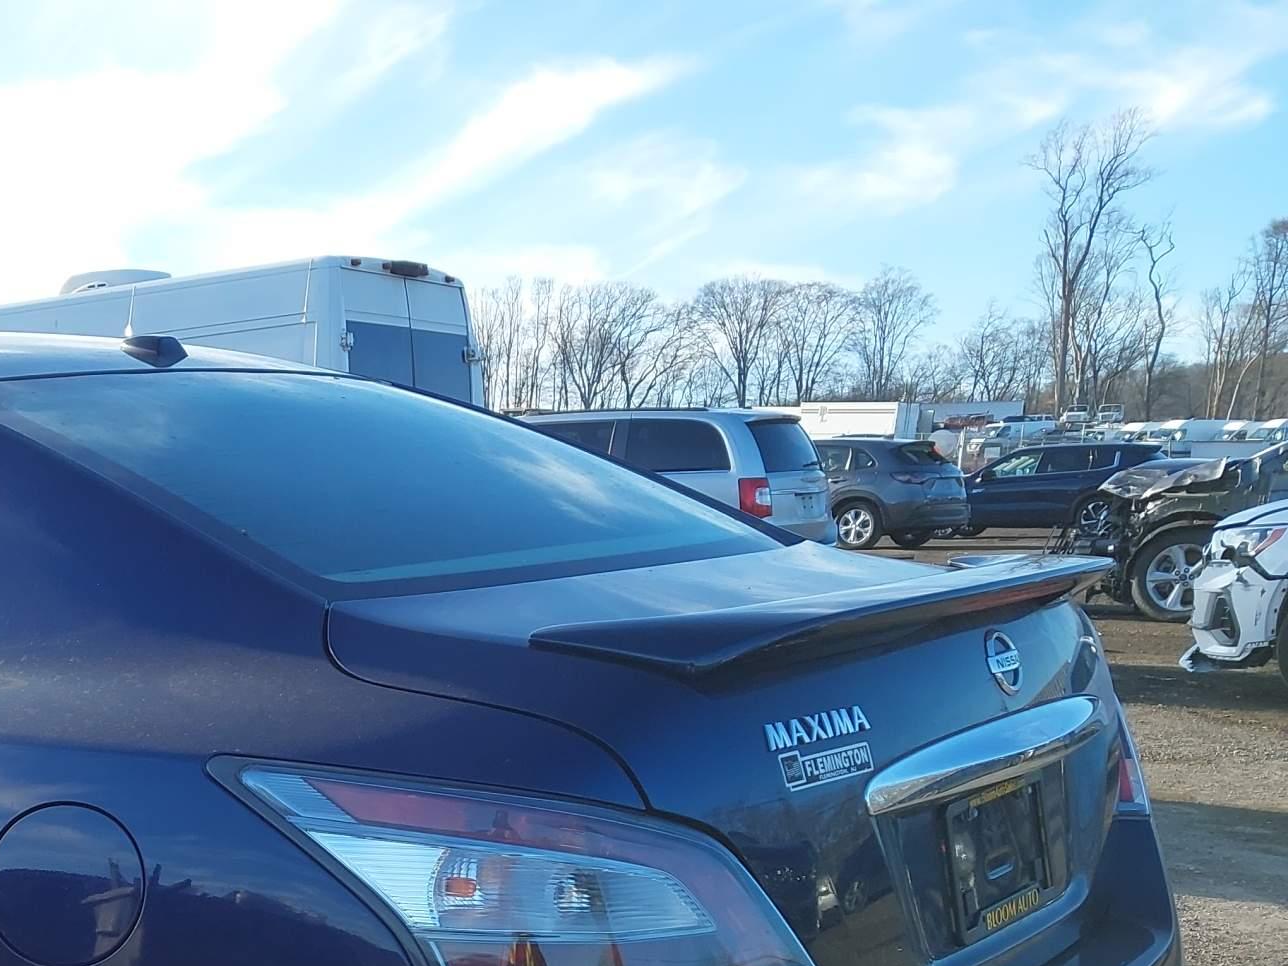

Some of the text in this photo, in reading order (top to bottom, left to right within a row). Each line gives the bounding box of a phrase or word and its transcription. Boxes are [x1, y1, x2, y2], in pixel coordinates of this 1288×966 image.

[763, 704, 872, 752] MAXIMA
[804, 746, 869, 777] FLEMINGTON
[986, 887, 1040, 931] BLOOM AUTO
